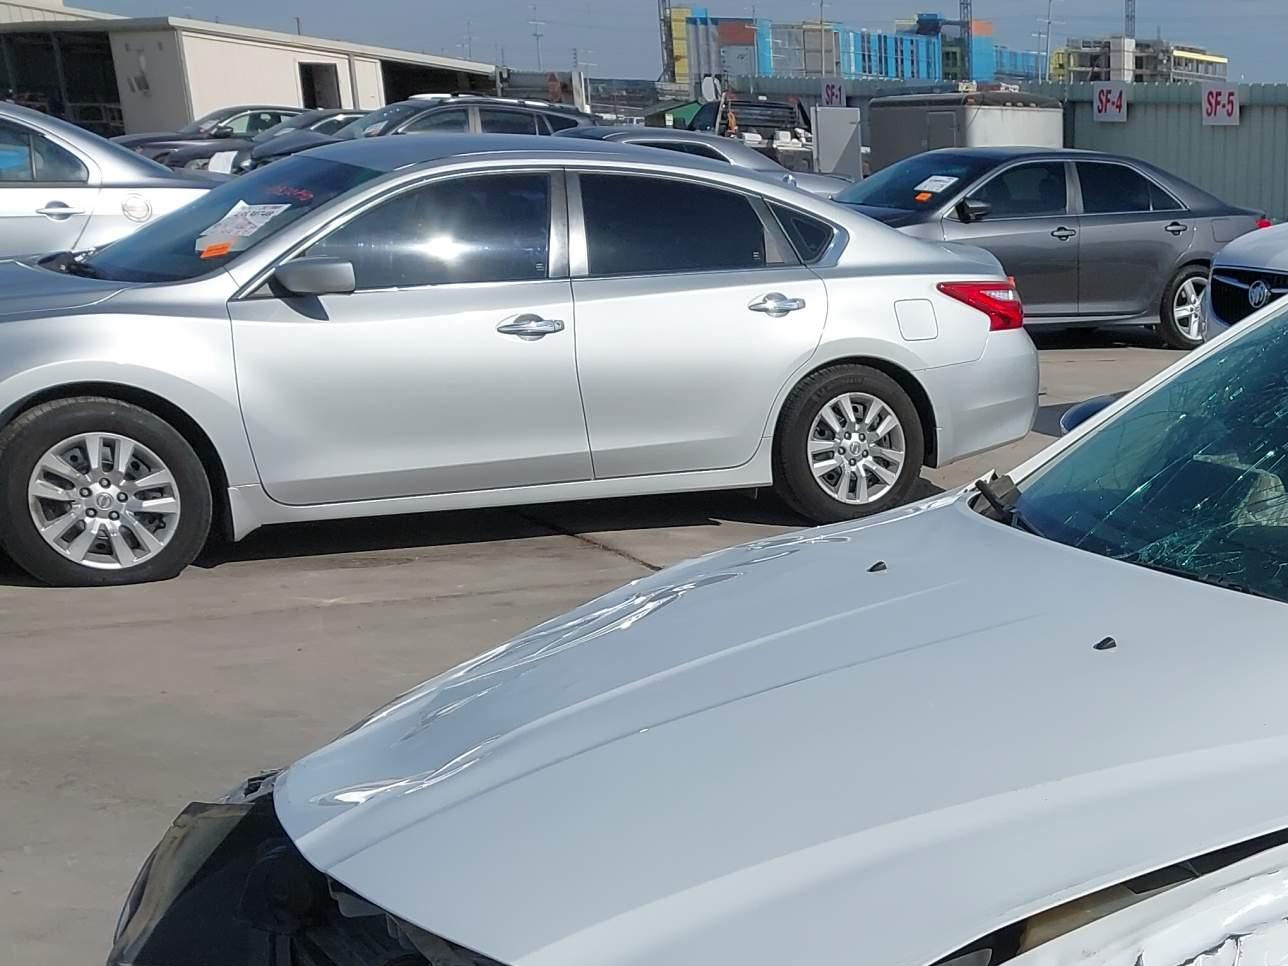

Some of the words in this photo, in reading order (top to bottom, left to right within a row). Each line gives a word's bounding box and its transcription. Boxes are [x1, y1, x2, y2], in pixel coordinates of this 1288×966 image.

[825, 84, 842, 105] SF-1
[1097, 89, 1123, 114] SF-4
[1206, 91, 1235, 117] SF-5
